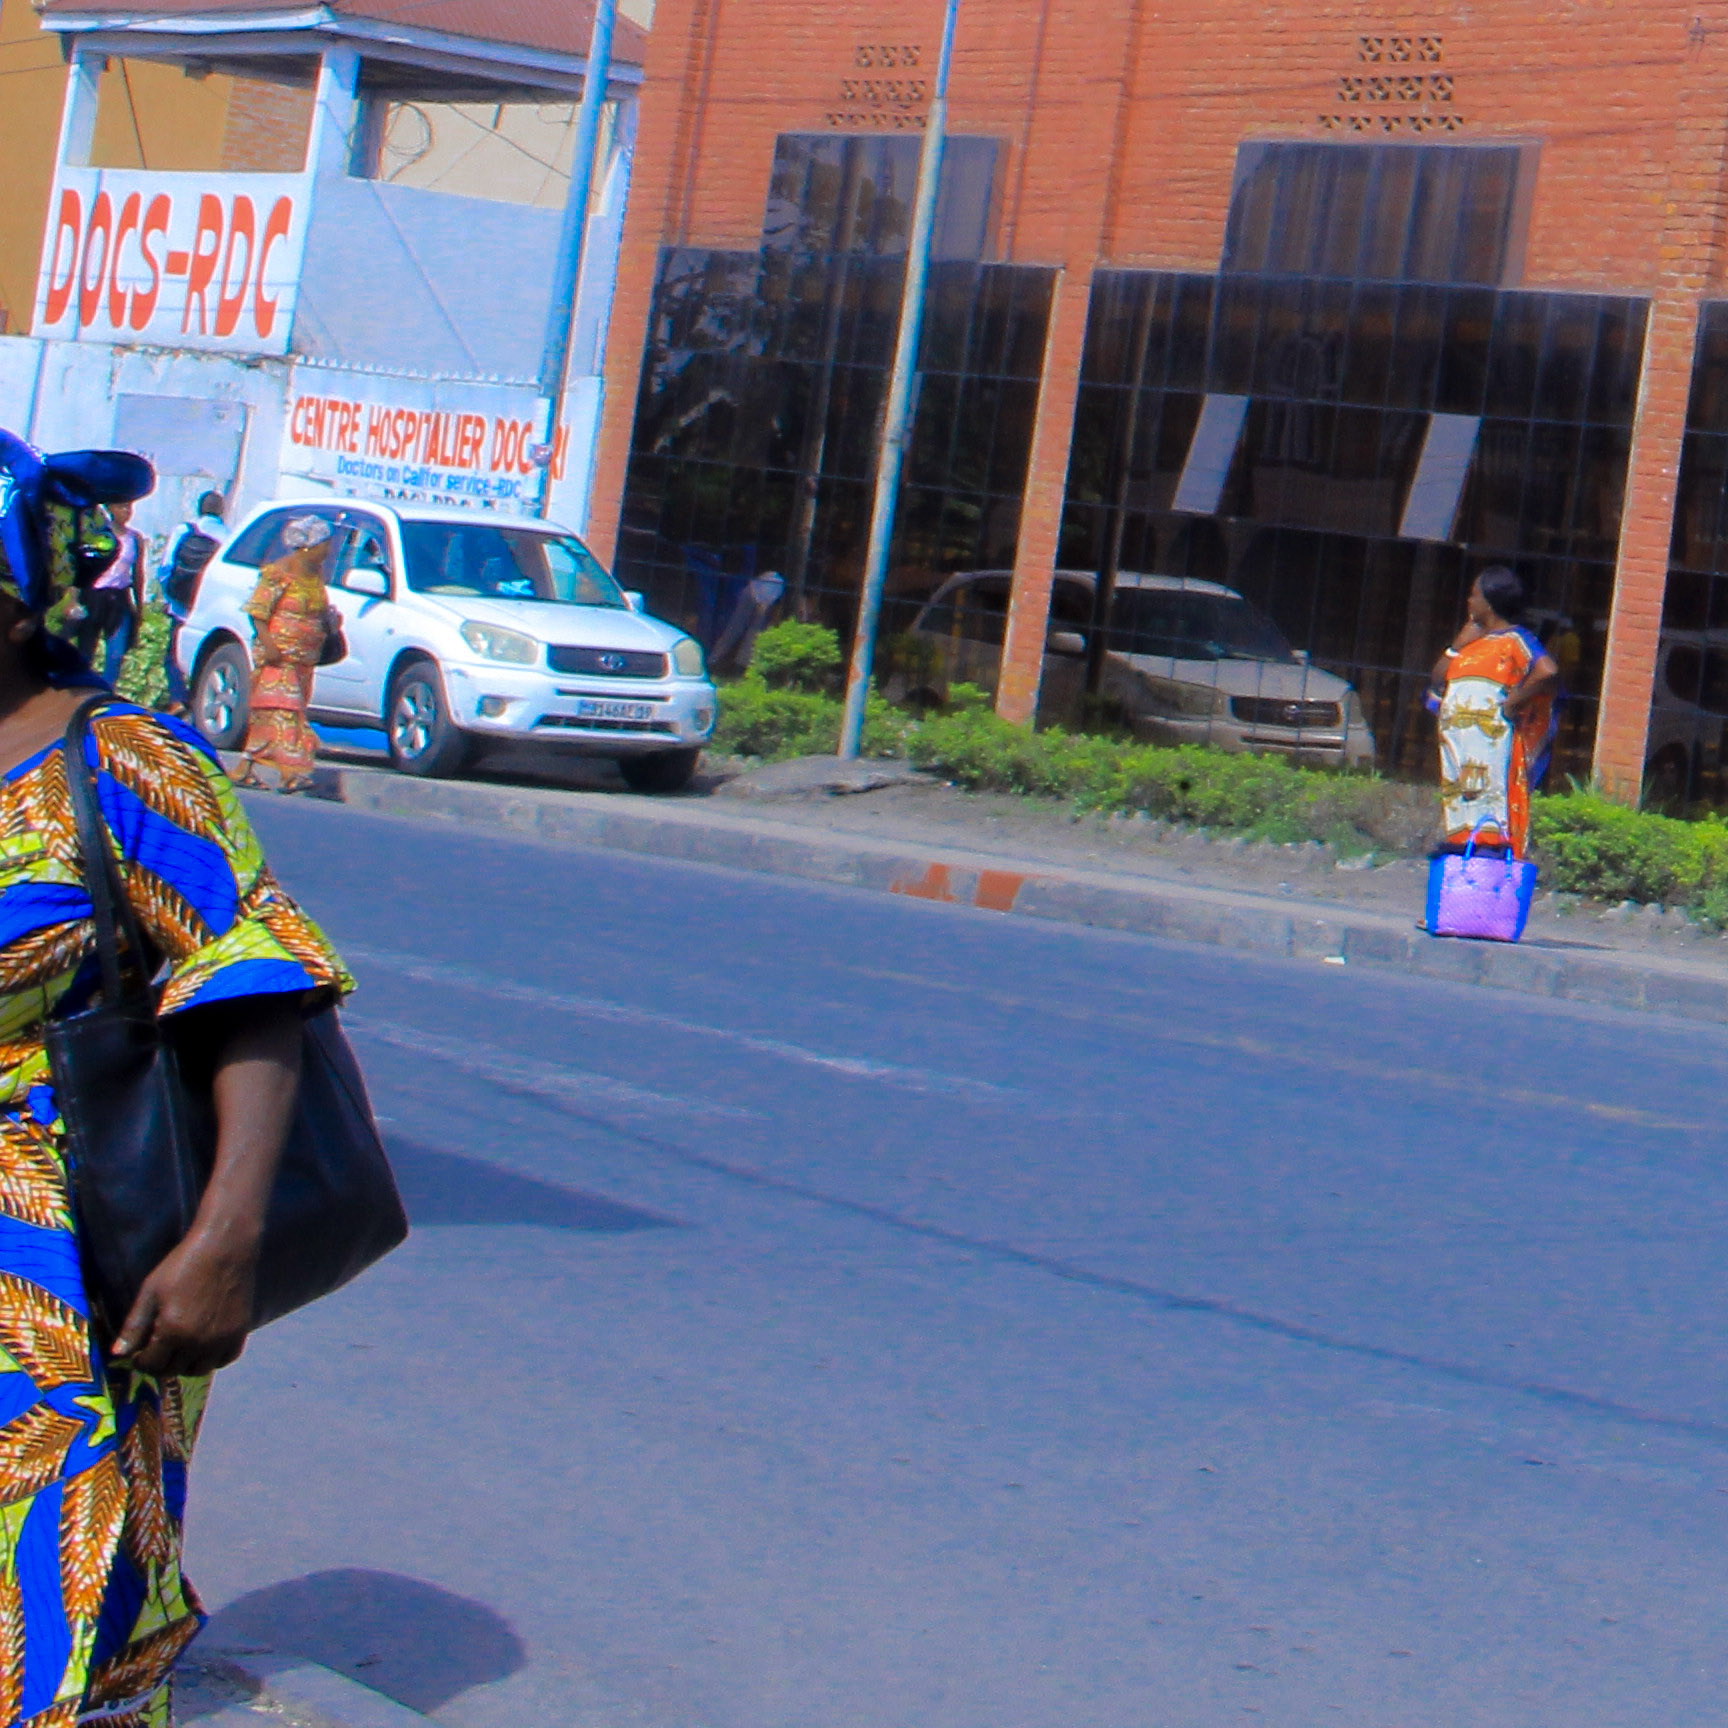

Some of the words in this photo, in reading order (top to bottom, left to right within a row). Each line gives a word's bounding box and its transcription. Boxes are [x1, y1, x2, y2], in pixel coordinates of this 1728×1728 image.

[44, 188, 293, 339] DOCS-RDC
[291, 396, 362, 453] CENTRE
[365, 404, 487, 470] HOSPITALIER
[338, 455, 384, 480] Doctors
[387, 467, 399, 483] on
